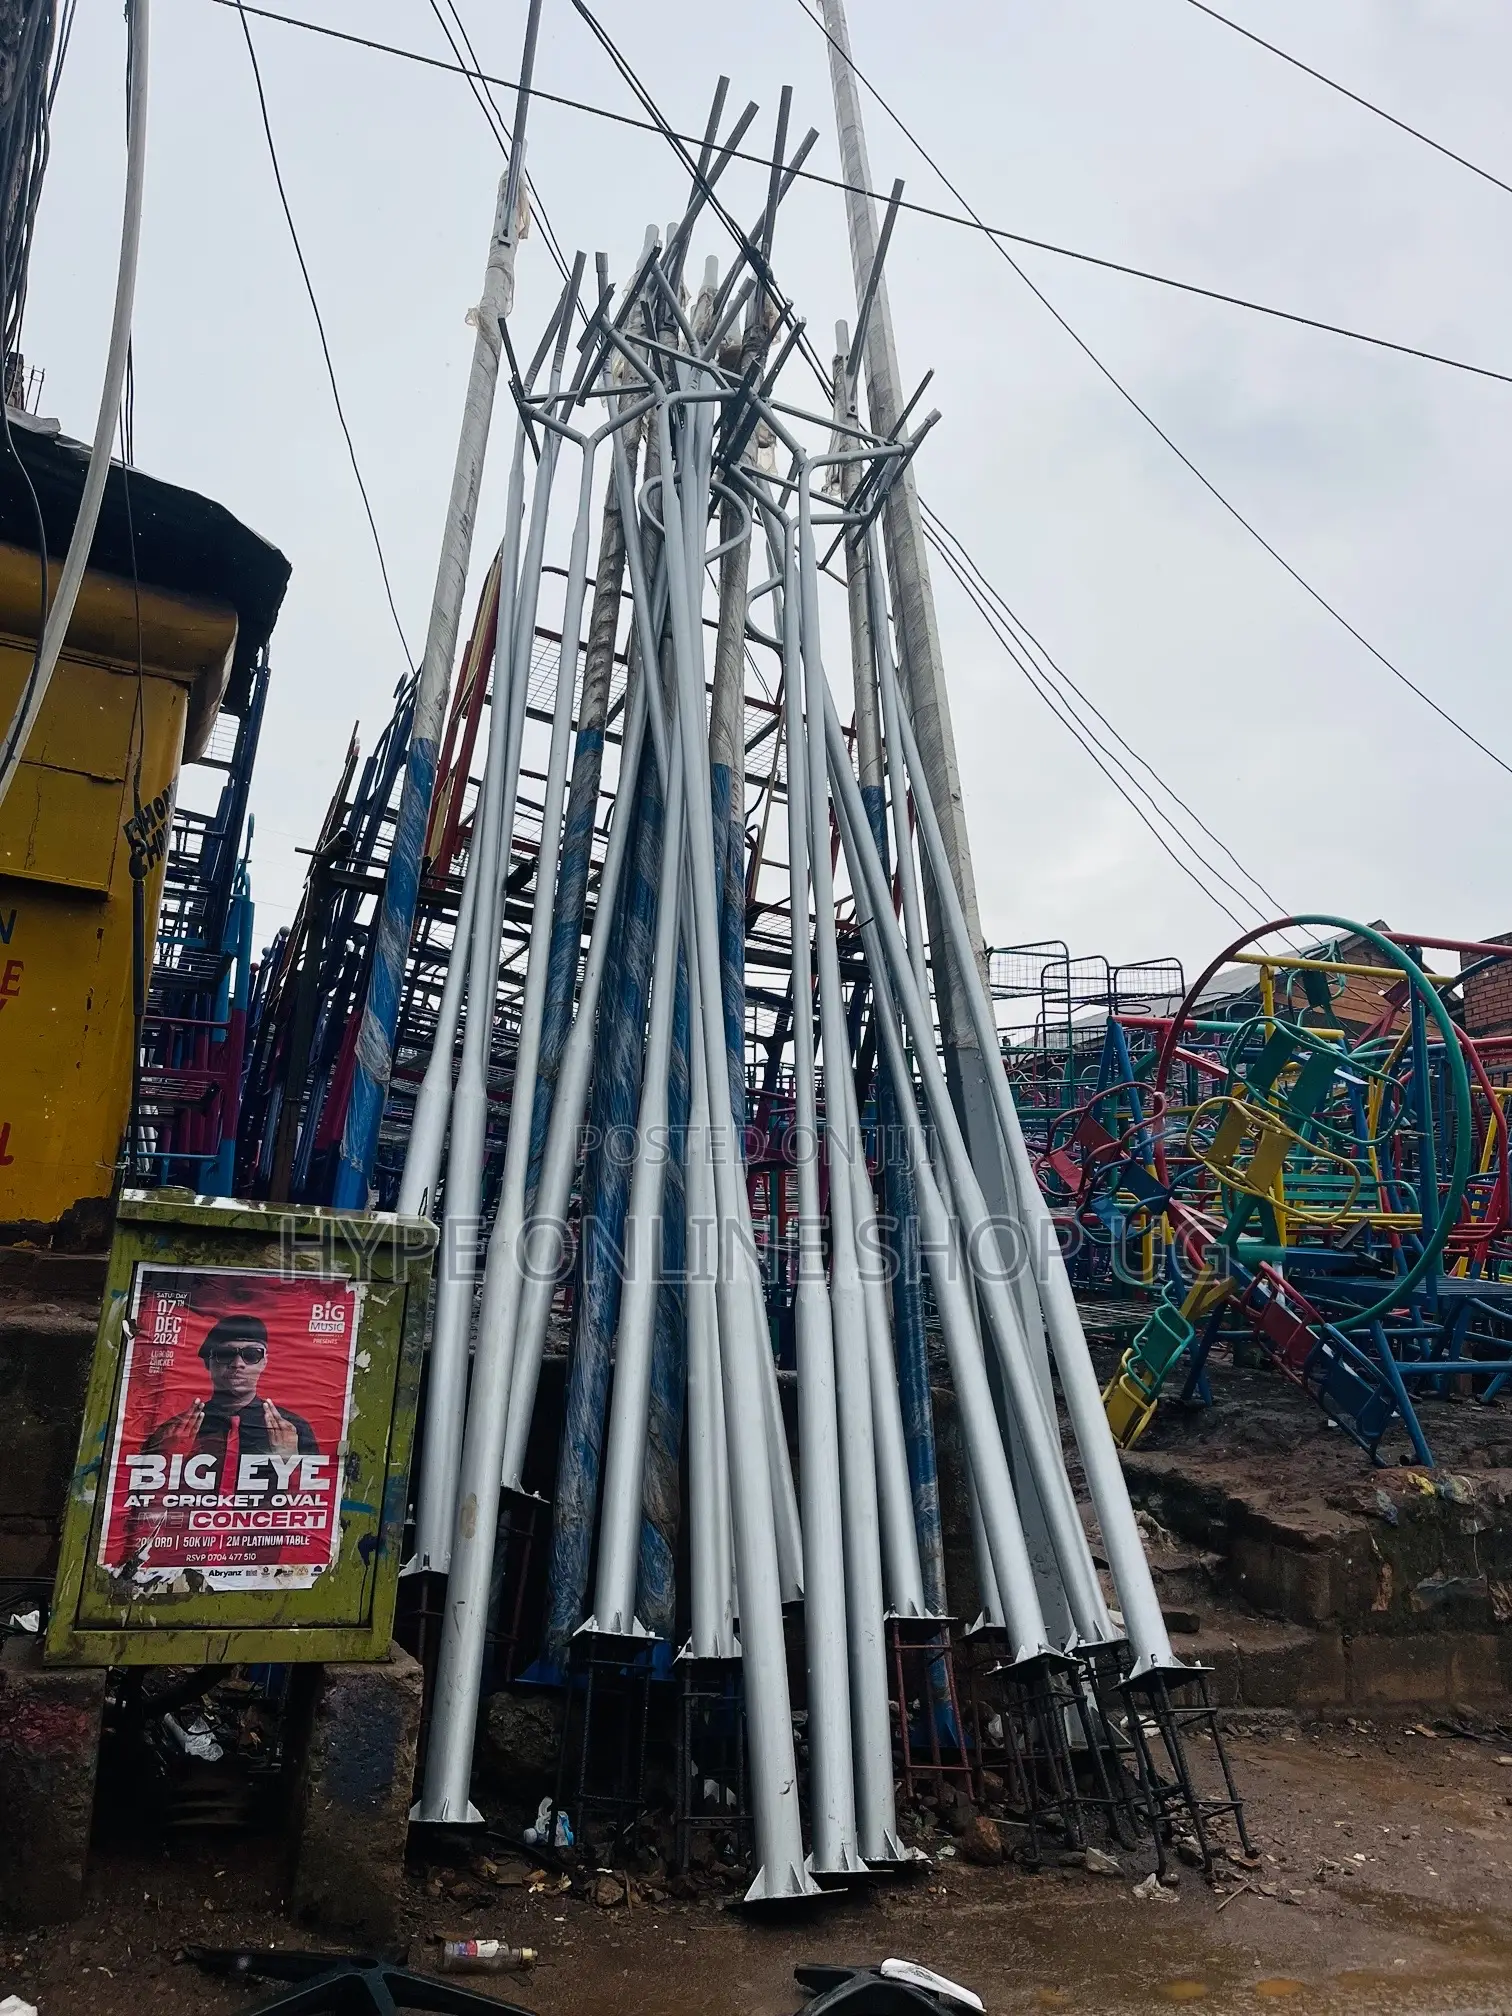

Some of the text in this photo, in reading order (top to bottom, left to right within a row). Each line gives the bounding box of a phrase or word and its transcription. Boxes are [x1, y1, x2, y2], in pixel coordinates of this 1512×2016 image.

[154, 1316, 182, 1333] DEC
[310, 1322, 343, 1332] MUSIC
[152, 1333, 179, 1345] 2024
[125, 1453, 330, 1491] BIG EYE
[123, 1494, 328, 1508] AT CRICKET OVAL
[192, 1511, 326, 1529] CONCERT
[154, 1536, 173, 1548] ORD
[183, 1536, 201, 1548] 50K
[202, 1535, 216, 1547] VIP
[226, 1535, 241, 1547] 2M
[241, 1534, 284, 1547] PLATINUM
[285, 1534, 311, 1546] TABLE
[185, 1552, 257, 1562] RSVP 0704 477 510
[208, 1569, 243, 1578] Abryanz
